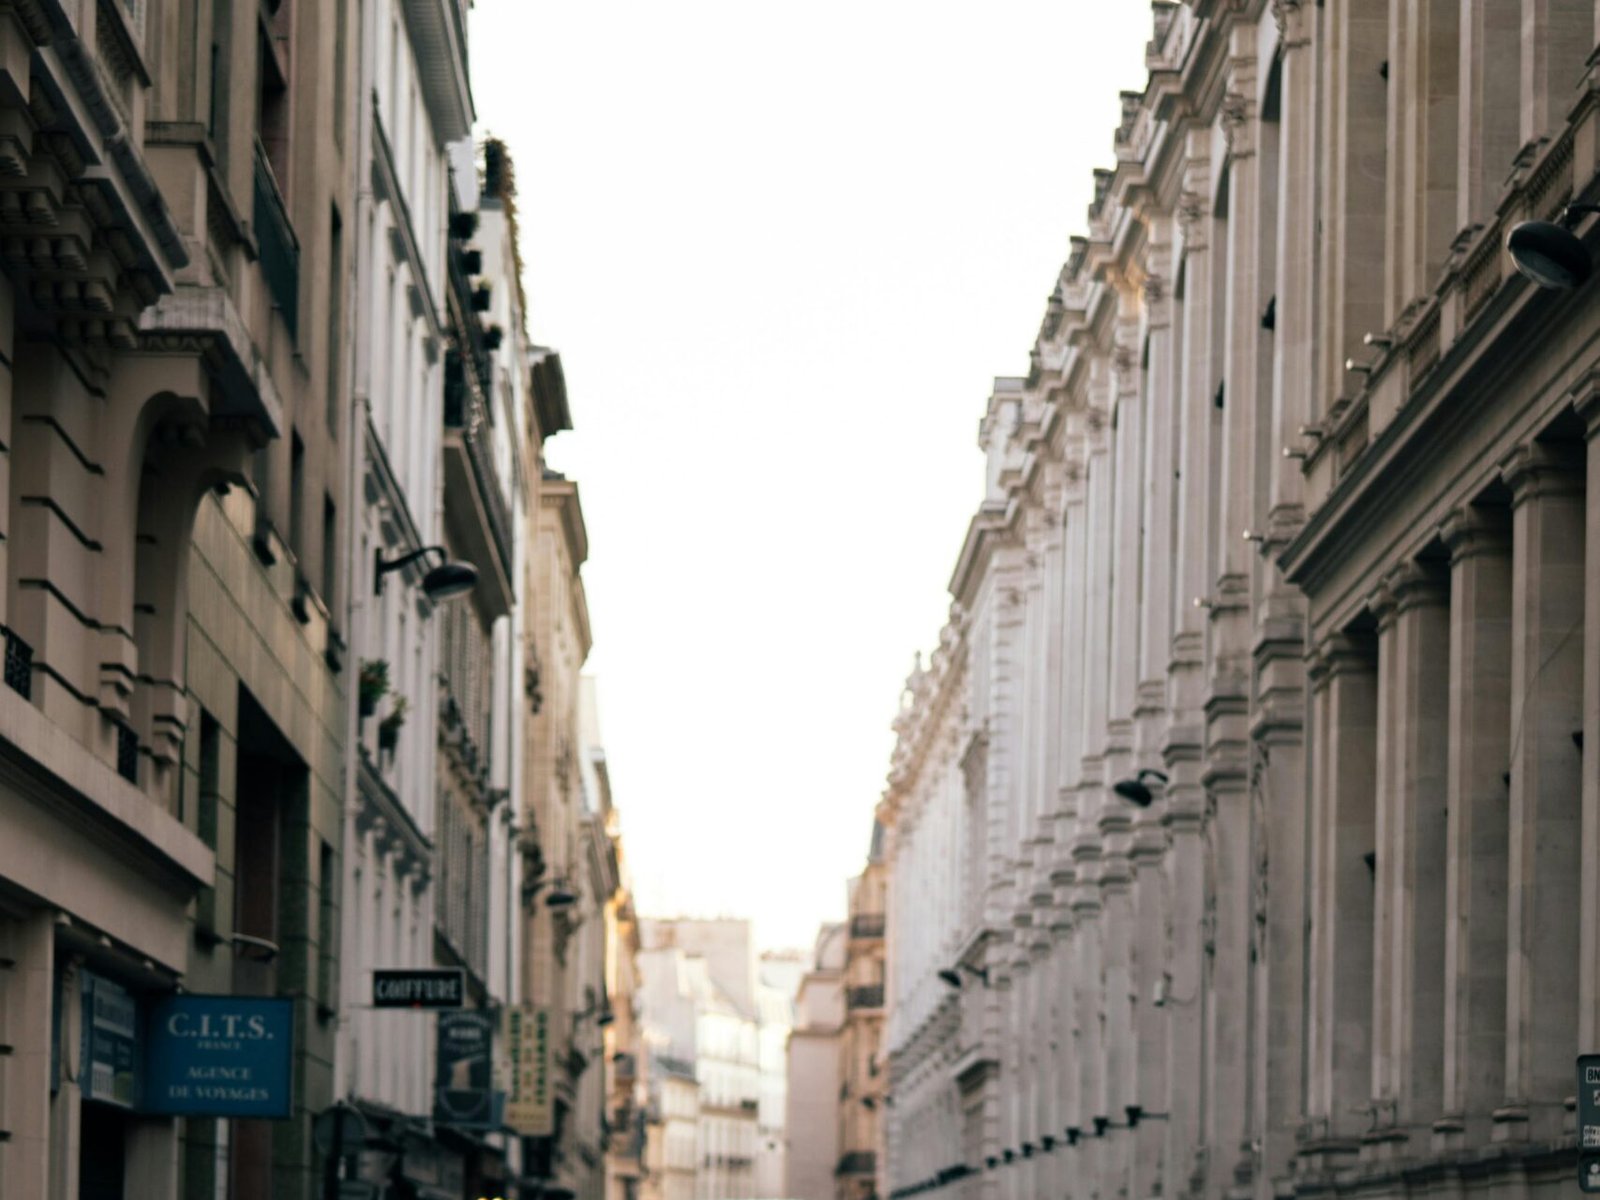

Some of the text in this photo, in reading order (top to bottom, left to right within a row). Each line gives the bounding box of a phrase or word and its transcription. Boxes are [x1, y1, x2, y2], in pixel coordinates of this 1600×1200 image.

[376, 979, 458, 1000] COIFFURE
[167, 1012, 275, 1040] C.I.T.S.
[196, 1040, 242, 1050] FRANCE
[187, 1066, 251, 1080] AGENCE
[168, 1086, 269, 1101] DE VOYAGES
